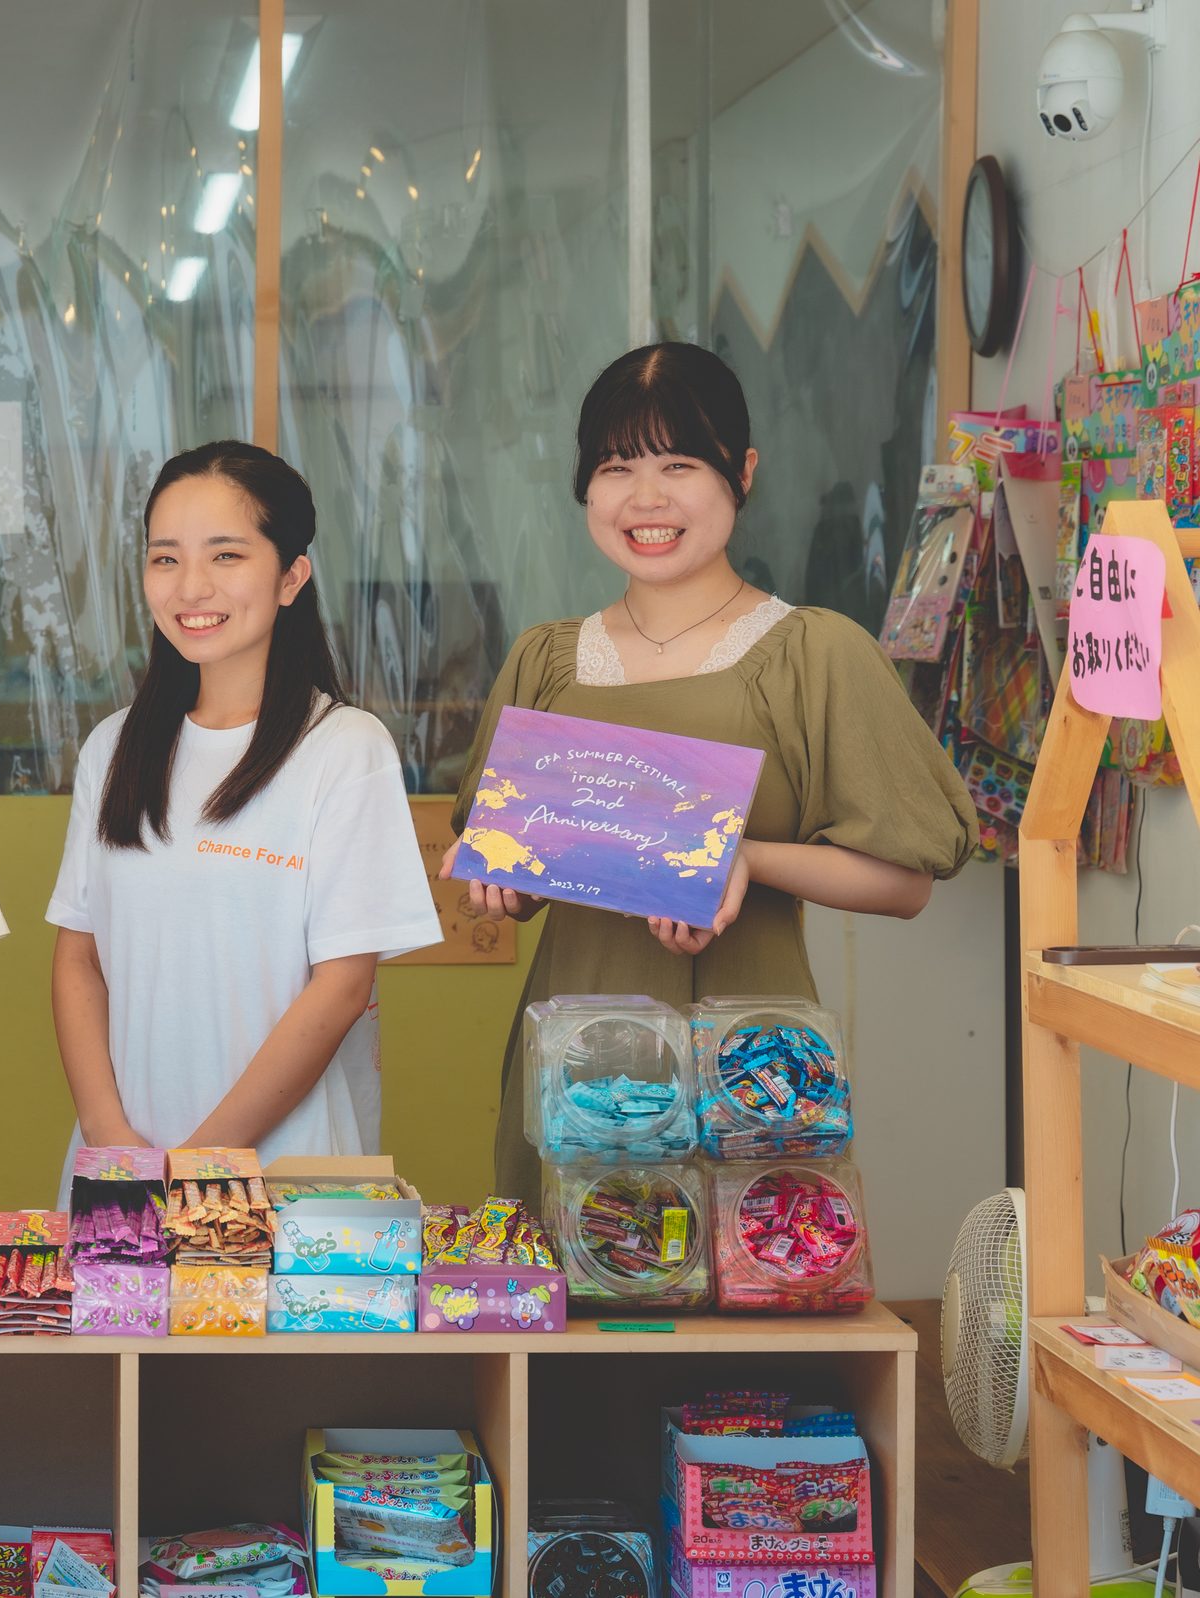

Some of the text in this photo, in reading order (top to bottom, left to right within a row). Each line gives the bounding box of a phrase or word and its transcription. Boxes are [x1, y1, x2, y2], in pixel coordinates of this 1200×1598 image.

[1073, 631, 1149, 679] お取りください
[535, 749, 686, 798] CFA SUMMER FESTIVAL
[571, 771, 636, 792] irodori
[572, 788, 624, 810] 2nd
[523, 804, 668, 850] Anniversary
[197, 839, 251, 858] Chance
[256, 847, 284, 866] For
[301, 1239, 336, 1255] サイダー
